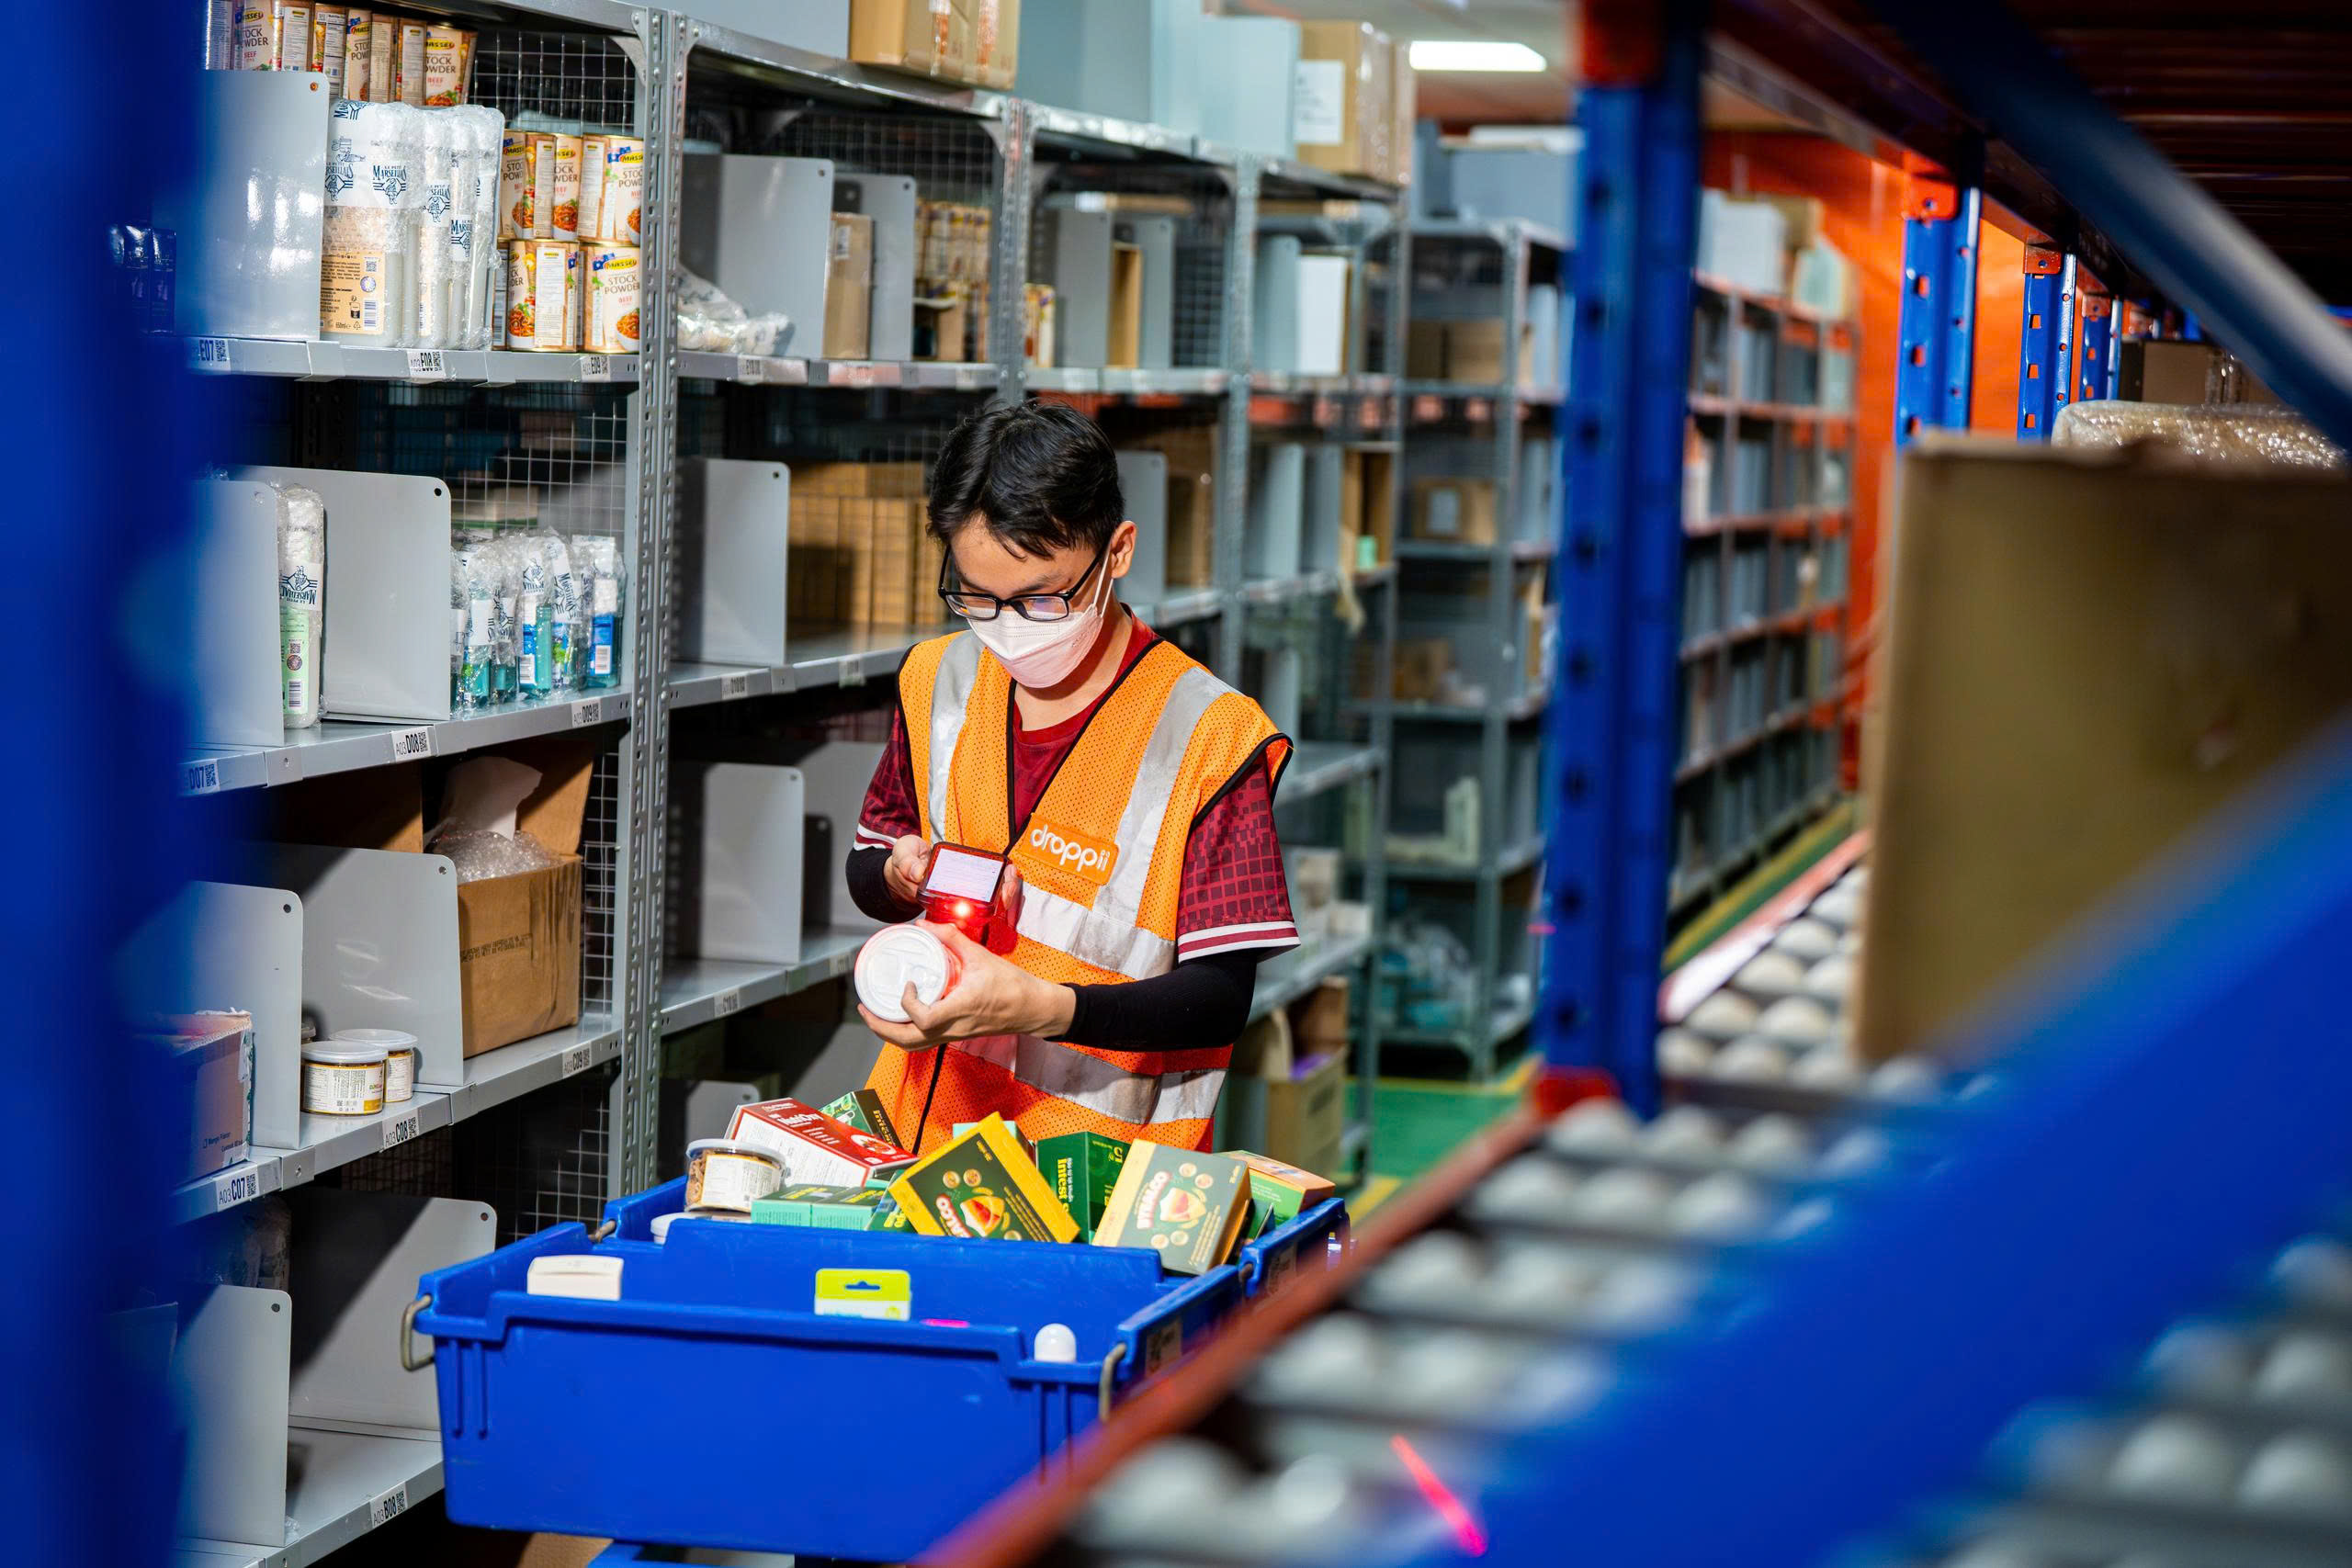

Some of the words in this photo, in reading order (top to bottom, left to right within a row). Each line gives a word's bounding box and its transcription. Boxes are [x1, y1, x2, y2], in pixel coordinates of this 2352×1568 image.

[244, 10, 264, 19] SSEL
[243, 28, 263, 38] OCK
[244, 38, 268, 47] WDER
[426, 56, 451, 65] TOCK
[622, 152, 643, 163] MASS
[326, 164, 354, 179] RSEILLAIS
[554, 165, 573, 175] OCK
[554, 174, 579, 183] WDER
[606, 258, 637, 269] MASSEL
[608, 275, 637, 285] STOCK
[1031, 824, 1110, 873] droppii
